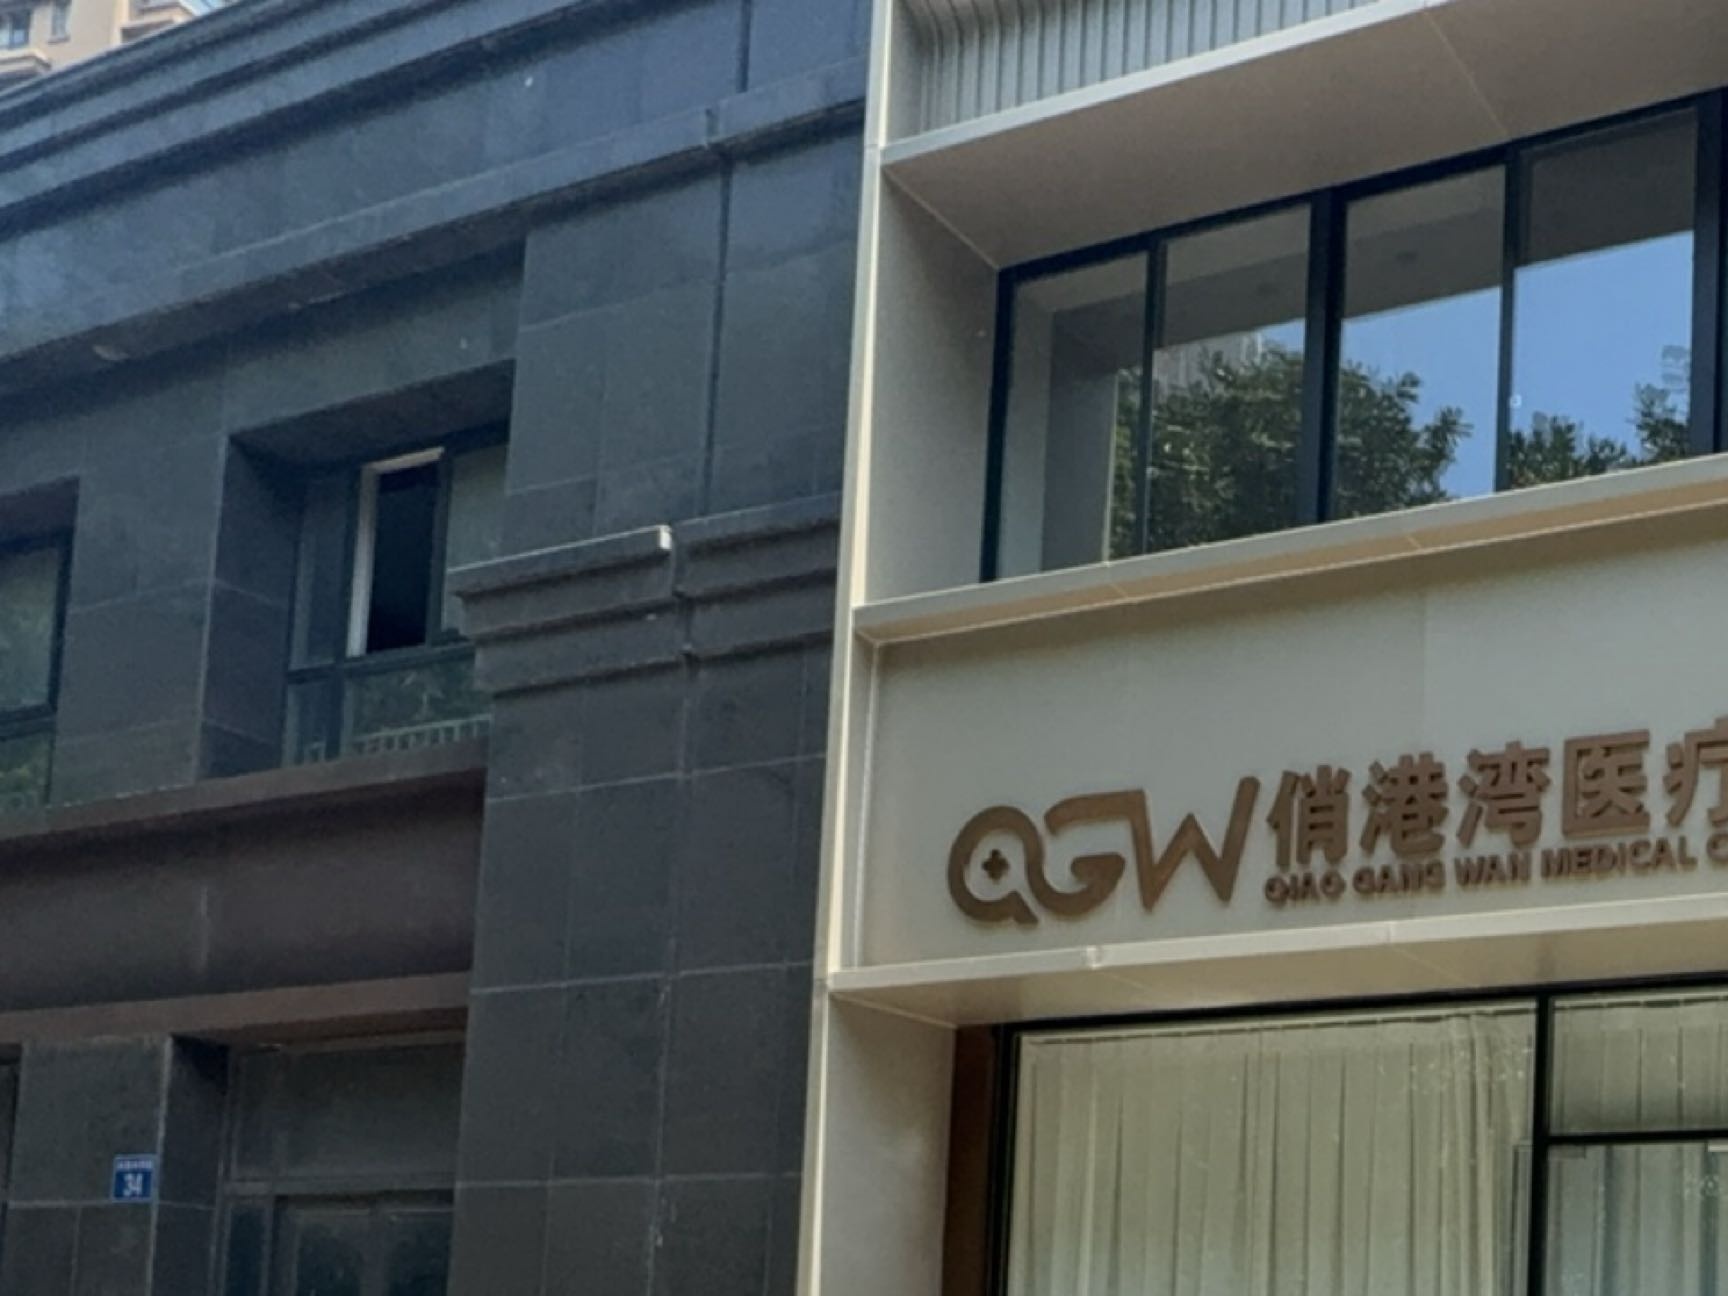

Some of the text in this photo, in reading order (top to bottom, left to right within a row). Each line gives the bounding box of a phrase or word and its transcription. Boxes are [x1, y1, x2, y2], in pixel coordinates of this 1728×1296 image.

[1265, 869, 1346, 905] QIAO
[1352, 861, 1446, 896] GANG
[1454, 852, 1532, 887] WAN
[1540, 838, 1697, 880] MEDICAL
[122, 1172, 143, 1197] 34
